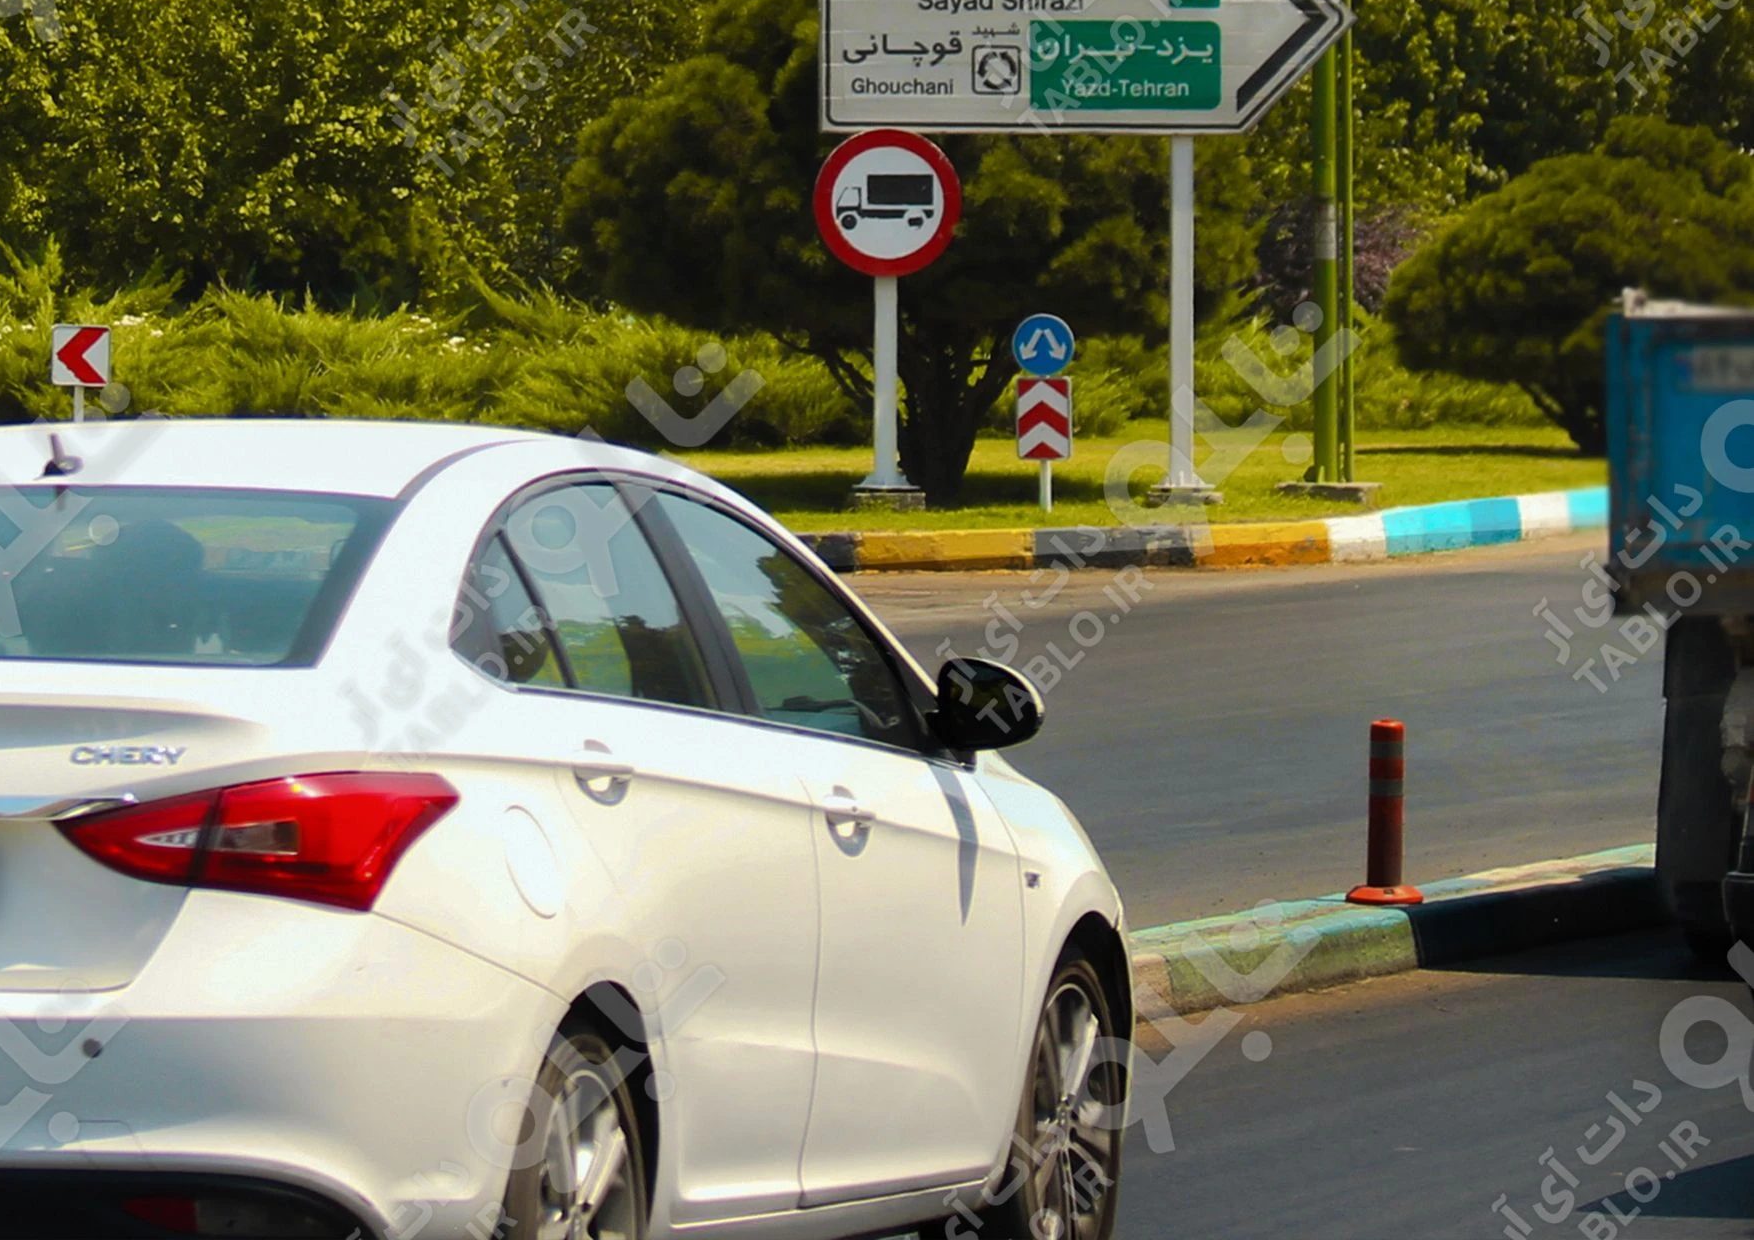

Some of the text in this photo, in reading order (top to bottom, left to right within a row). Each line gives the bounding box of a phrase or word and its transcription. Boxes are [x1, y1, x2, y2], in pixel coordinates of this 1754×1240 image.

[971, 22, 1021, 36] شهید
[842, 29, 964, 67] قوچانی
[851, 77, 955, 96] Ghouchani
[1060, 78, 1190, 99] Yazd-Tehran
[69, 745, 187, 766] CHERY
